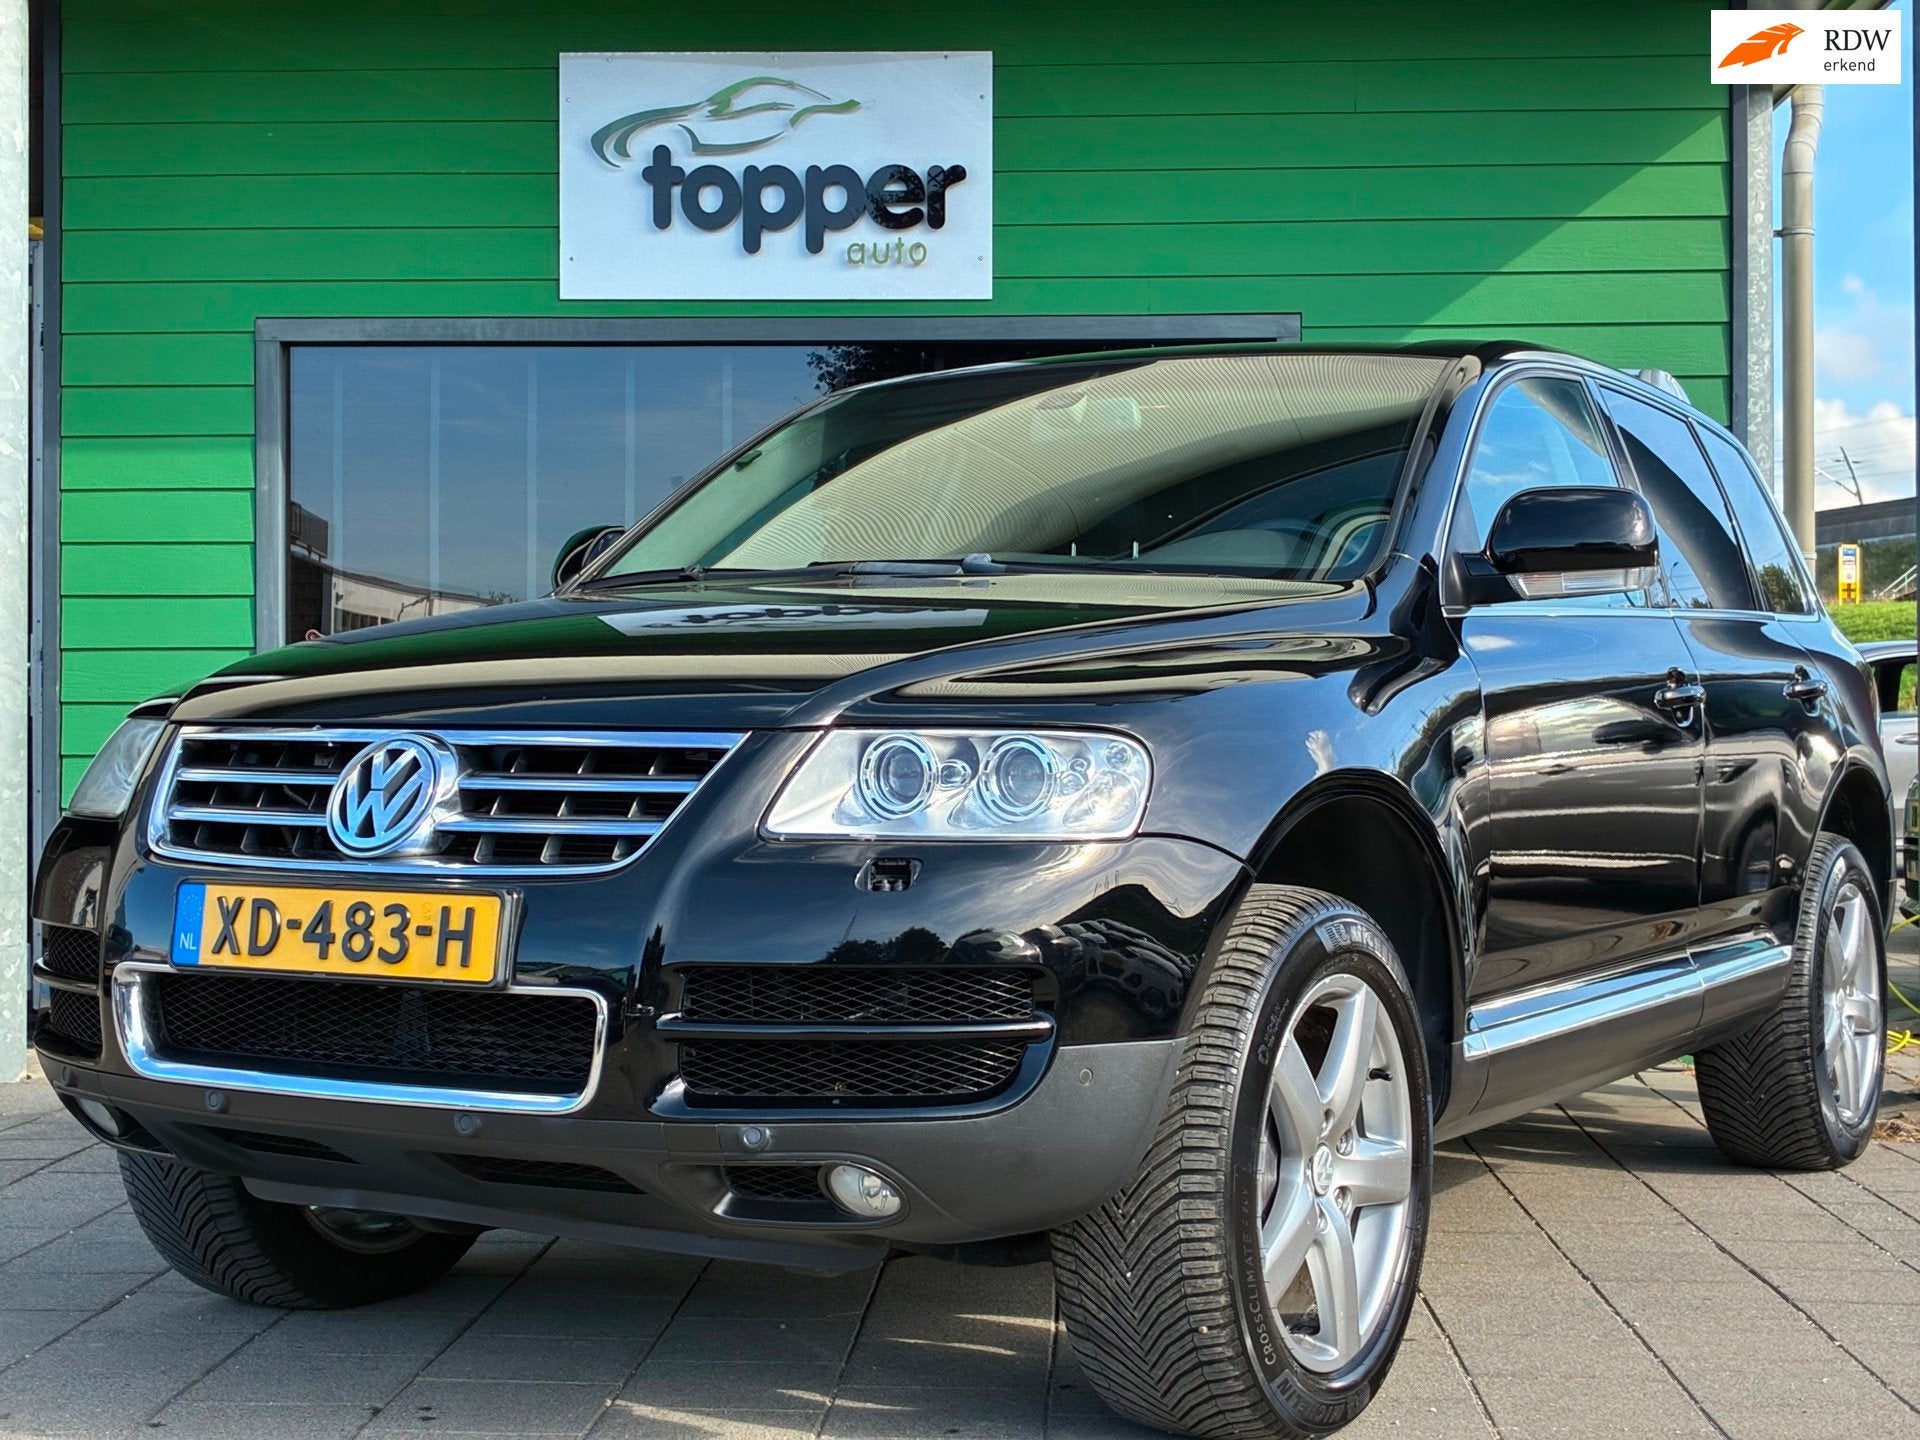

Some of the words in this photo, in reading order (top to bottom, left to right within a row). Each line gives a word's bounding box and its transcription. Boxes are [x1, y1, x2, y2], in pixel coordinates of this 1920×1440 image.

[642, 144, 967, 255] topper
[847, 237, 928, 265] auto
[179, 932, 198, 950] NL
[211, 895, 476, 968] XD-483-H
